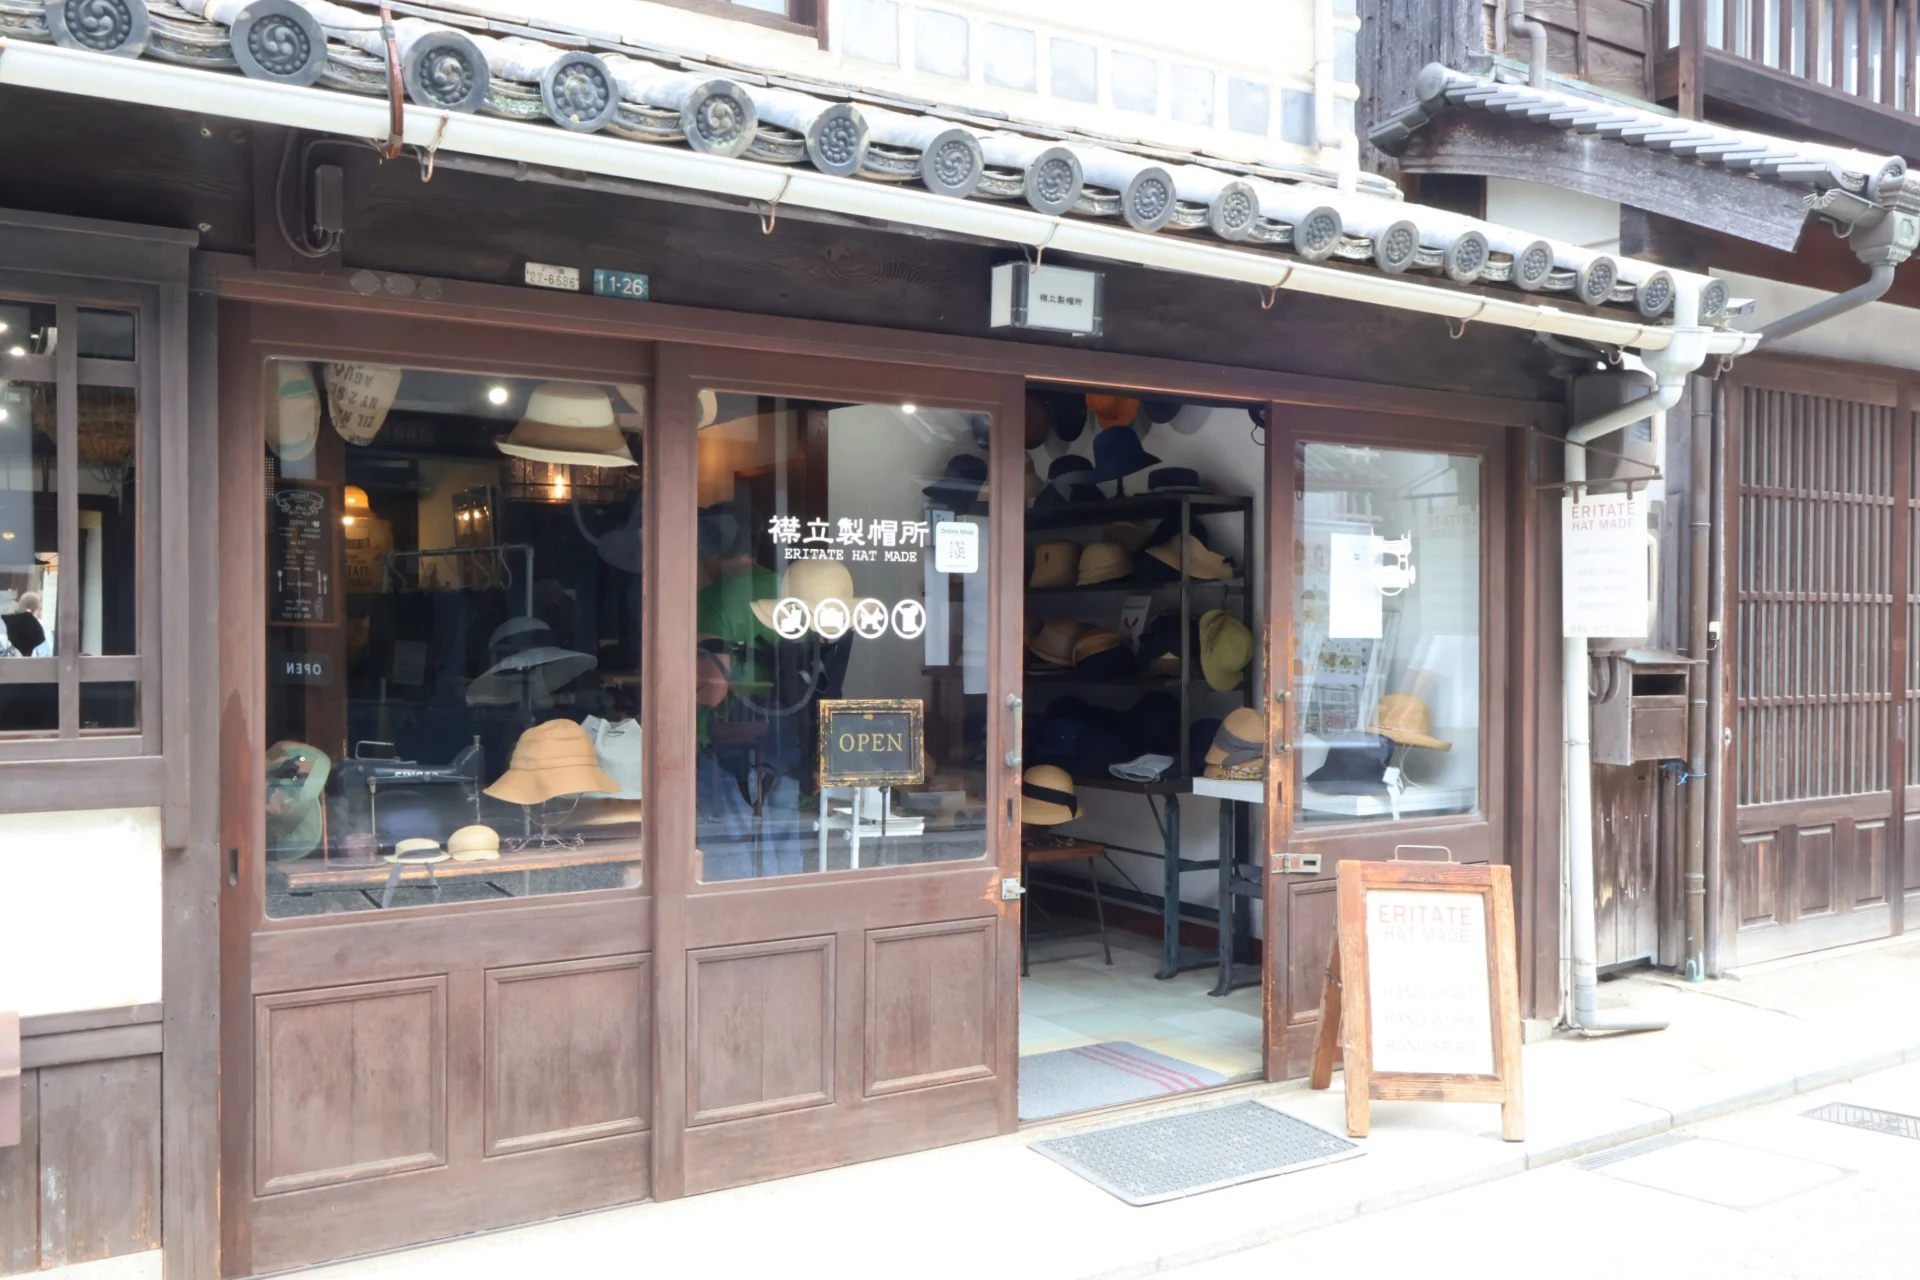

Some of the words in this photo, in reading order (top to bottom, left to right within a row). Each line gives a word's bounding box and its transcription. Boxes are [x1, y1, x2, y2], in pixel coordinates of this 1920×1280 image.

[598, 274, 644, 296] 11-26
[1572, 502, 1635, 519] ERITATE
[768, 515, 930, 548] 襟立製帽所
[960, 529, 975, 537] Shop
[1572, 519, 1594, 532] HAT
[1599, 518, 1634, 530] MADE
[784, 548, 844, 561] ERITATE
[852, 550, 877, 561] HAT
[884, 551, 917, 562] MADE
[839, 733, 903, 752] OPEN
[1379, 904, 1472, 926] ERITATE
[1384, 926, 1415, 942] HAT
[1421, 927, 1469, 943] MADE
[1383, 986, 1425, 1000] HAND
[1384, 1012, 1425, 1027] HAND
[1386, 1038, 1427, 1055] HAND
[1431, 1040, 1477, 1055] SPIRIT
